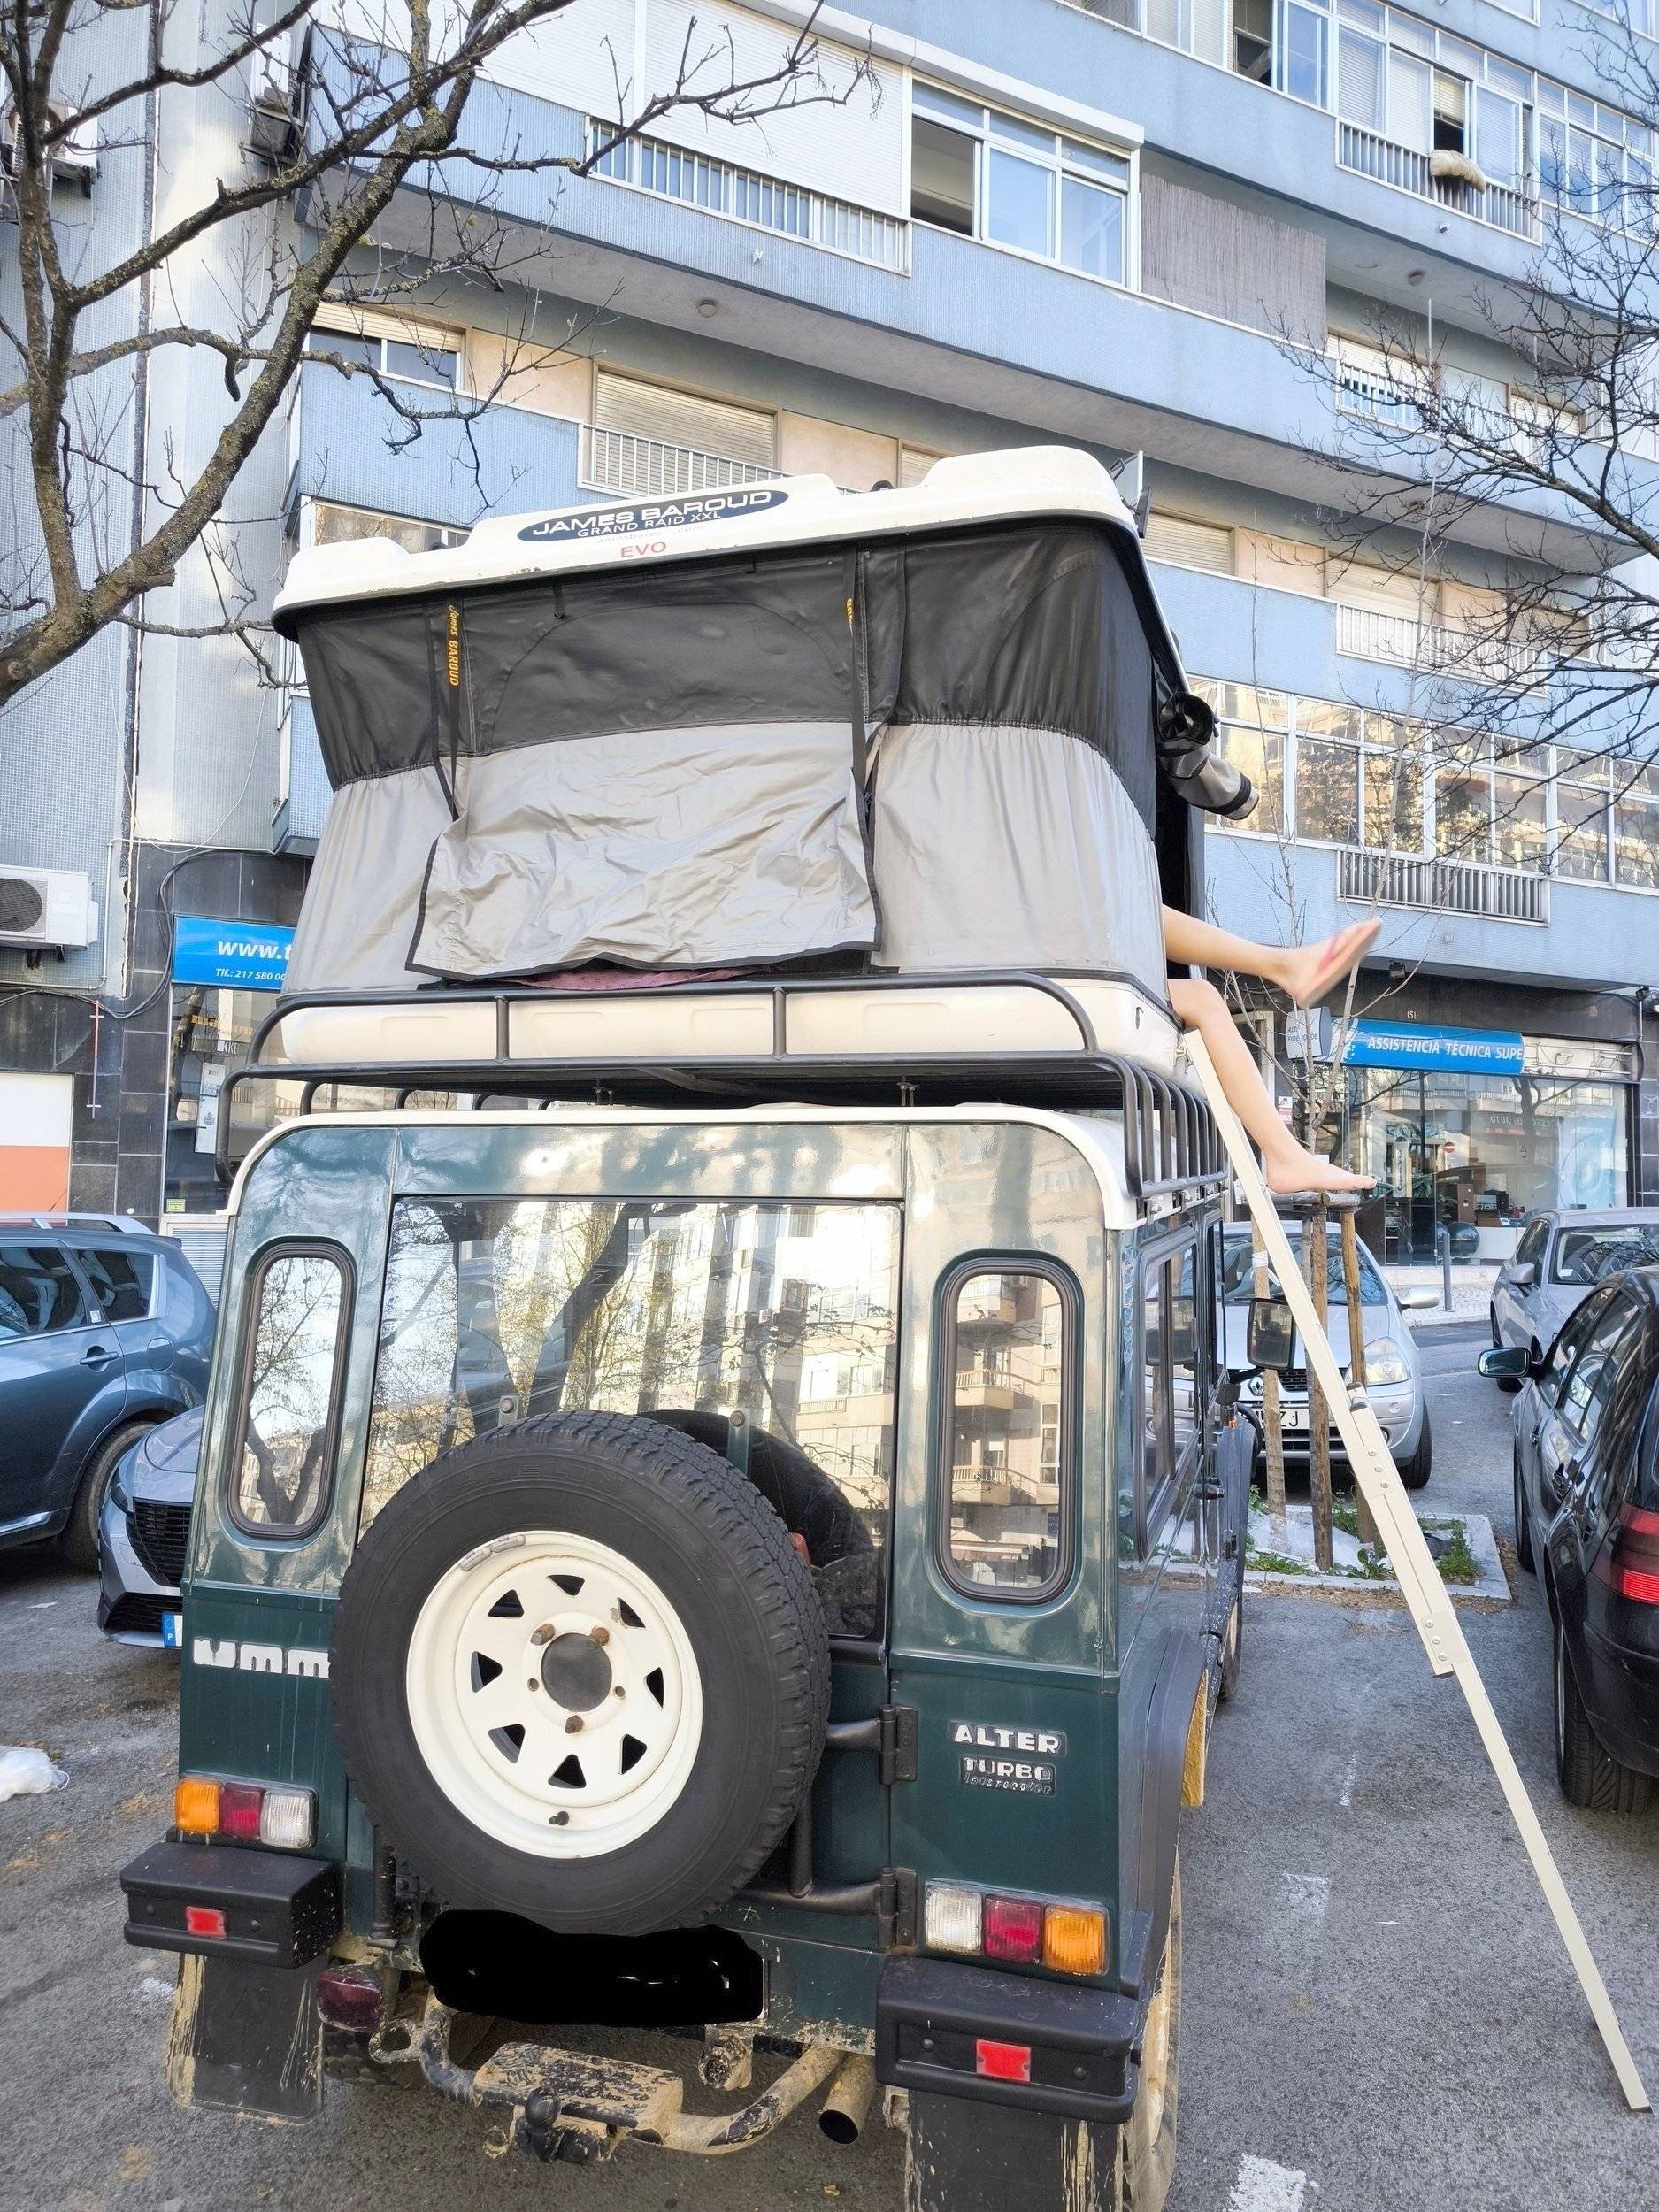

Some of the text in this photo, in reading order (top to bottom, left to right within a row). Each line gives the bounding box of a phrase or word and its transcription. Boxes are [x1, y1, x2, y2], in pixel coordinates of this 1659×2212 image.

[533, 491, 772, 536] JAMES BAROUD
[577, 511, 722, 538] GRAND RAID XXL
[620, 541, 667, 558] EVO
[449, 605, 460, 686] James BAROUD
[234, 971, 253, 979] 217
[254, 972, 273, 981] 580
[1445, 1041, 1492, 1059] TÉCNICA
[954, 1724, 1060, 1754] ALTER
[964, 1757, 1052, 1781] TURBO
